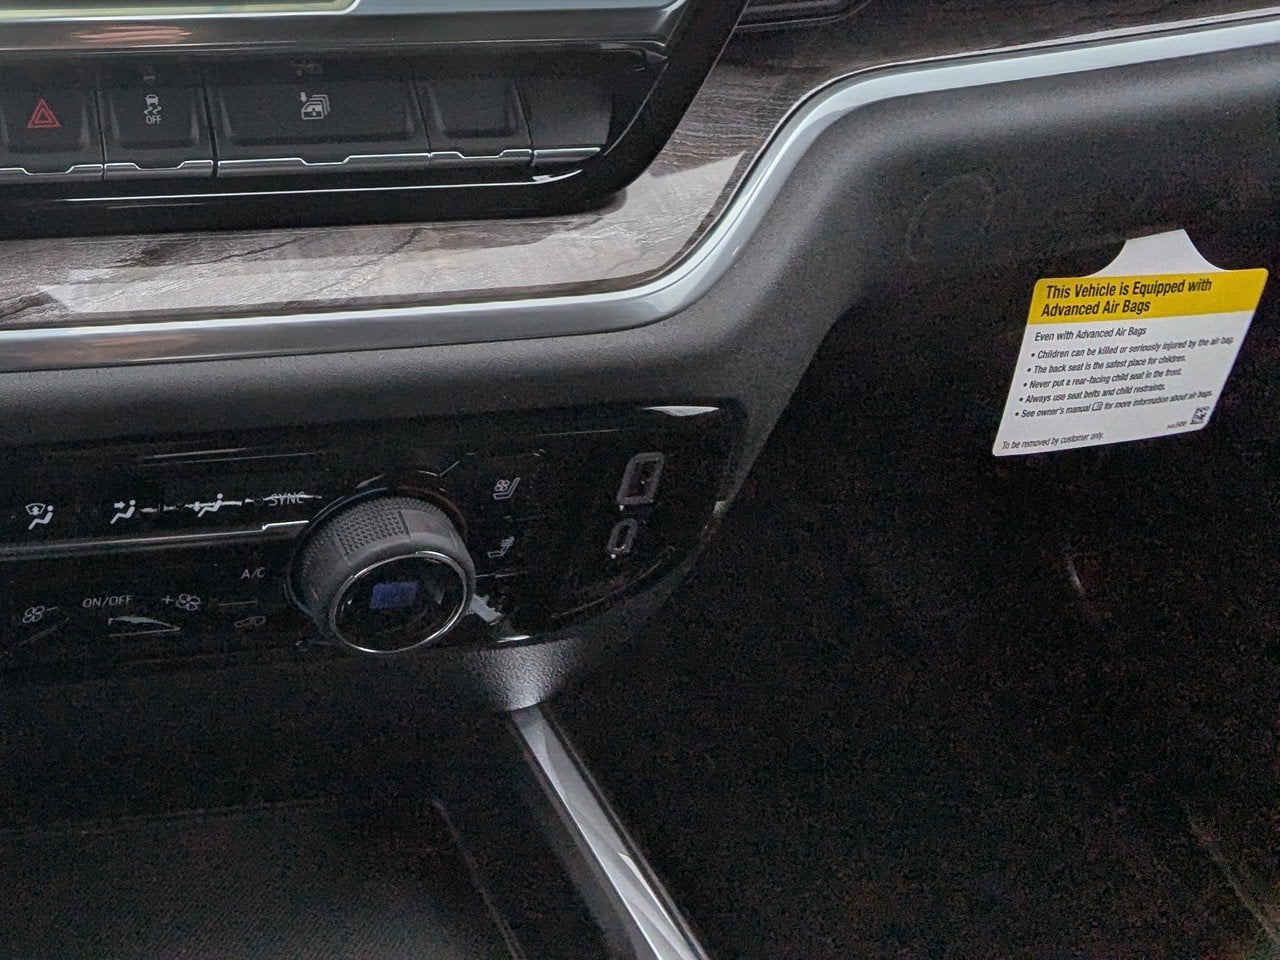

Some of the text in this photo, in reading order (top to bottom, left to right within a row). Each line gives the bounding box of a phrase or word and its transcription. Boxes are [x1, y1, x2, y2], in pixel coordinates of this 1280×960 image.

[145, 114, 162, 125] OFF
[1046, 278, 1212, 299] This Vehicle is Equipped with
[1041, 299, 1151, 317] Advanced Air Bags
[1034, 326, 1147, 342] Even with Advanced Air Bags
[1037, 349, 1069, 359] Children
[1071, 349, 1085, 357] can
[1086, 347, 1097, 356] be
[1098, 345, 1118, 355] killed
[1120, 346, 1128, 354] or
[1129, 342, 1161, 353] seriously
[1162, 340, 1187, 351] injured
[1188, 340, 1197, 349] by
[1033, 365, 1047, 374] The
[1048, 364, 1066, 374] back
[1067, 362, 1083, 372] seat
[1084, 362, 1092, 370] is
[1093, 361, 1104, 370] the
[1105, 359, 1127, 369] safest
[1127, 358, 1147, 369] place
[1147, 356, 1158, 365] for
[1029, 379, 1051, 389] Never
[1052, 379, 1064, 388] put
[1072, 375, 1110, 385] rear-facing
[1111, 372, 1129, 382] child
[1129, 371, 1145, 381] seat
[1145, 370, 1152, 379] in
[1153, 369, 1164, 378] the
[1025, 394, 1051, 404] Always
[1052, 393, 1066, 401] use
[1067, 391, 1083, 400] seat
[1084, 389, 1101, 399] belts
[1101, 387, 1116, 397] and
[1116, 386, 1133, 395] child
[1021, 409, 1035, 418] See
[1065, 404, 1091, 414] manual
[1104, 402, 1113, 410] for
[1114, 400, 1132, 409] more
[1002, 441, 1010, 450] To
[1011, 440, 1020, 449] be
[1021, 438, 1050, 448] removed
[1051, 436, 1060, 446] by
[1060, 433, 1090, 444] customer
[269, 491, 305, 506] SYNC
[240, 566, 266, 580] A/C
[82, 595, 133, 609] ON/OFF
